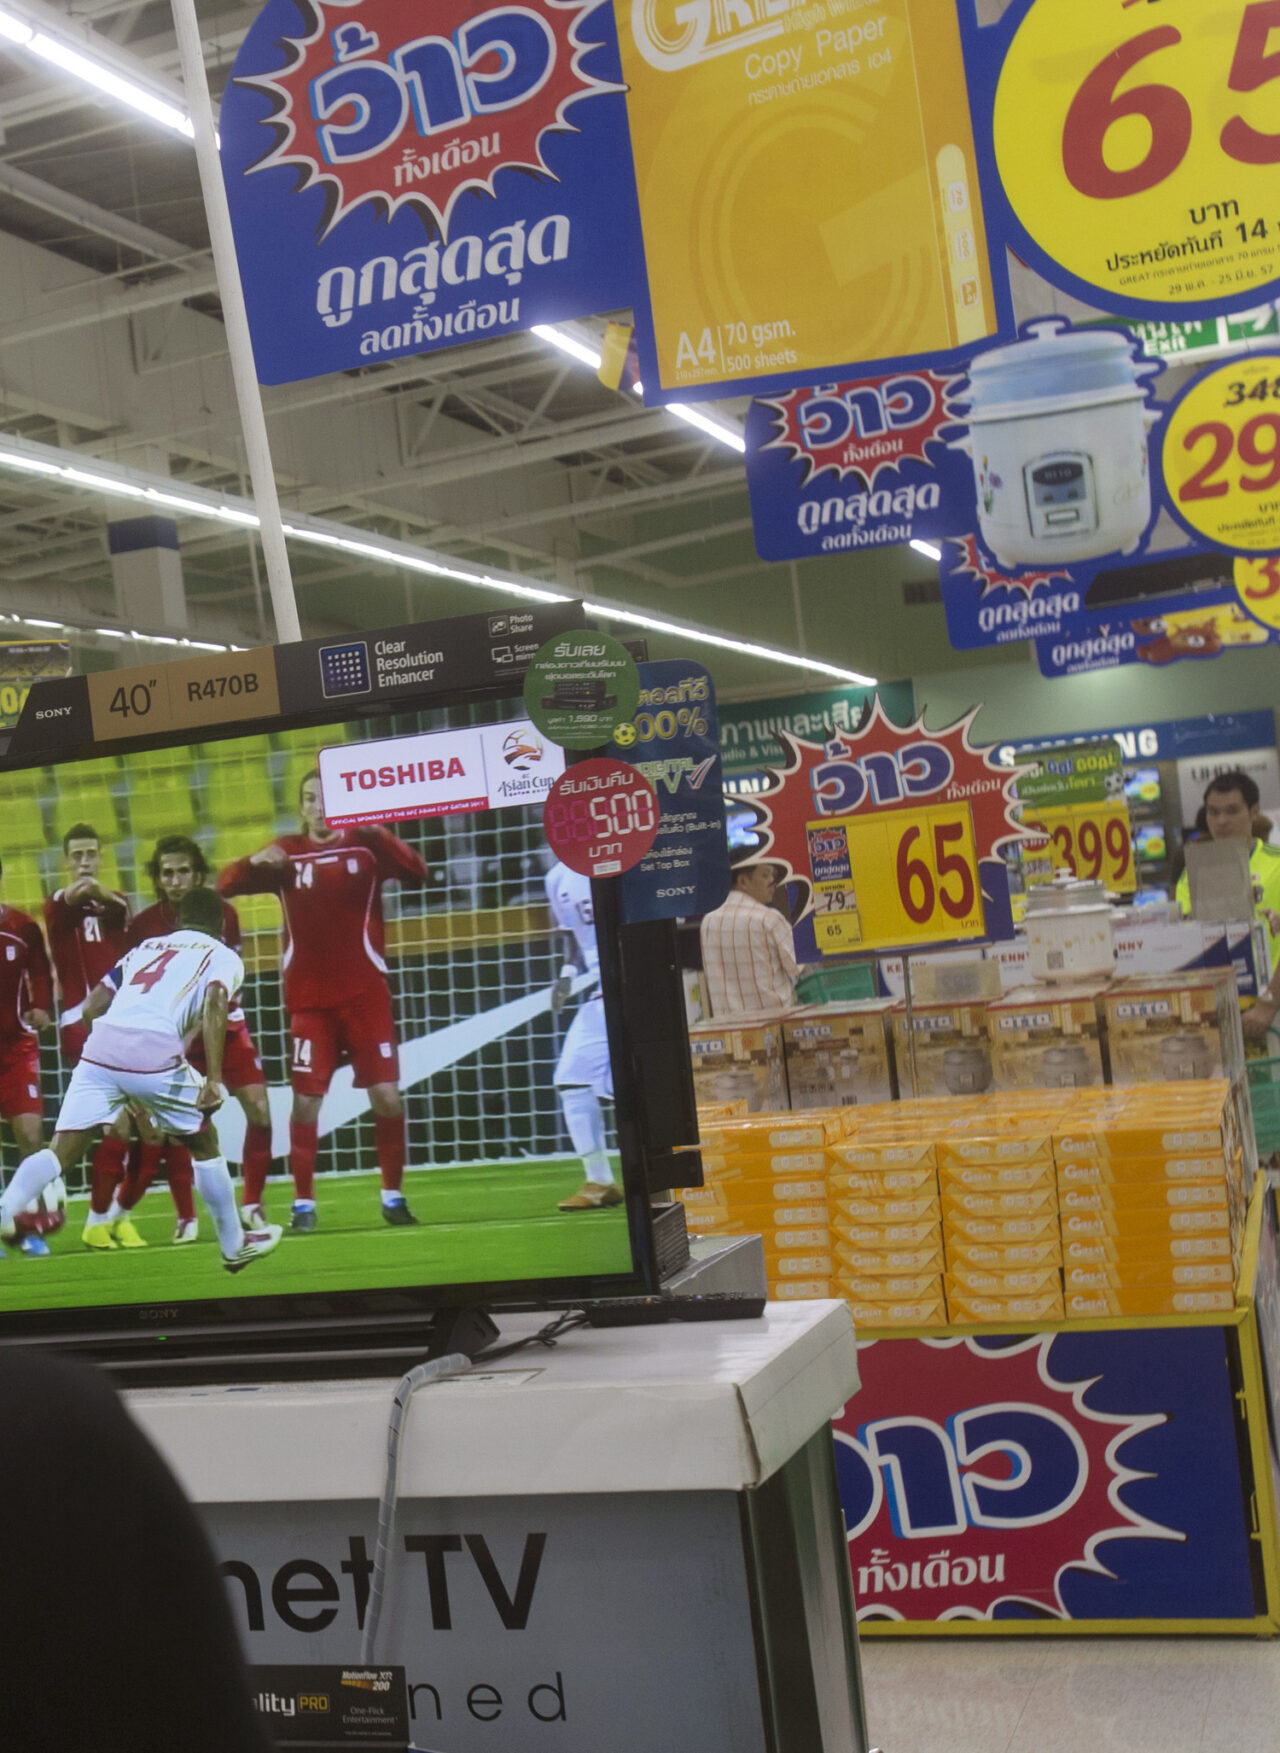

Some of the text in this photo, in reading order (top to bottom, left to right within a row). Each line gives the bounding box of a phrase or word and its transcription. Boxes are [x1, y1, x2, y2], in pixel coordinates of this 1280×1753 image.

[744, 44, 803, 80] Copy
[816, 16, 887, 57] Paper
[309, 5, 557, 165] ว้าว
[393, 132, 501, 187] ทั้งเดือน
[1189, 199, 1240, 225] บาท
[1105, 217, 1269, 272] ประหยัดทันที 14
[315, 214, 571, 328] ถูกสุดสุด
[359, 298, 520, 356] ลดทั้งเดือน
[675, 318, 797, 368] A4 70 gsm.
[727, 348, 798, 373] 500 sheets
[842, 438, 904, 464] ทั้งเดือน
[797, 481, 941, 535] ถูกสุดสุด
[821, 523, 913, 552] ลดทั้งเดือน
[509, 614, 534, 624] Photo
[510, 623, 534, 634] Share
[375, 640, 407, 656] Clear
[514, 642, 540, 653] Screen
[554, 642, 606, 658] รับเลย
[376, 651, 444, 673] Resolution
[378, 668, 435, 688] Enhancer
[35, 706, 73, 720] SONY
[187, 672, 259, 702] R470B
[720, 746, 747, 762] udio
[340, 757, 466, 792] TOSHIBA
[498, 776, 555, 797] Asian Cup
[559, 771, 634, 796] รับเงินคืน
[810, 739, 955, 816] ว้าว
[946, 775, 1002, 800] ทั้งเดือน
[589, 789, 655, 839] 500
[588, 842, 623, 858] บาท
[1053, 818, 1130, 881] 399
[656, 860, 671, 871] Top
[672, 859, 691, 869] Box
[896, 821, 975, 925] 65
[656, 885, 696, 898] SONY
[823, 890, 845, 912] 79
[827, 924, 842, 936] 65
[130, 950, 180, 994] 4
[292, 1037, 312, 1064] 14
[139, 1307, 179, 1320] SONY
[404, 1532, 547, 1630] TV
[858, 1548, 1006, 1594] ทั้งเดือน
[342, 1670, 378, 1681] Motionflow
[372, 1681, 390, 1691] 200
[299, 1696, 329, 1711] PRO
[350, 1706, 385, 1716] One-Flick
